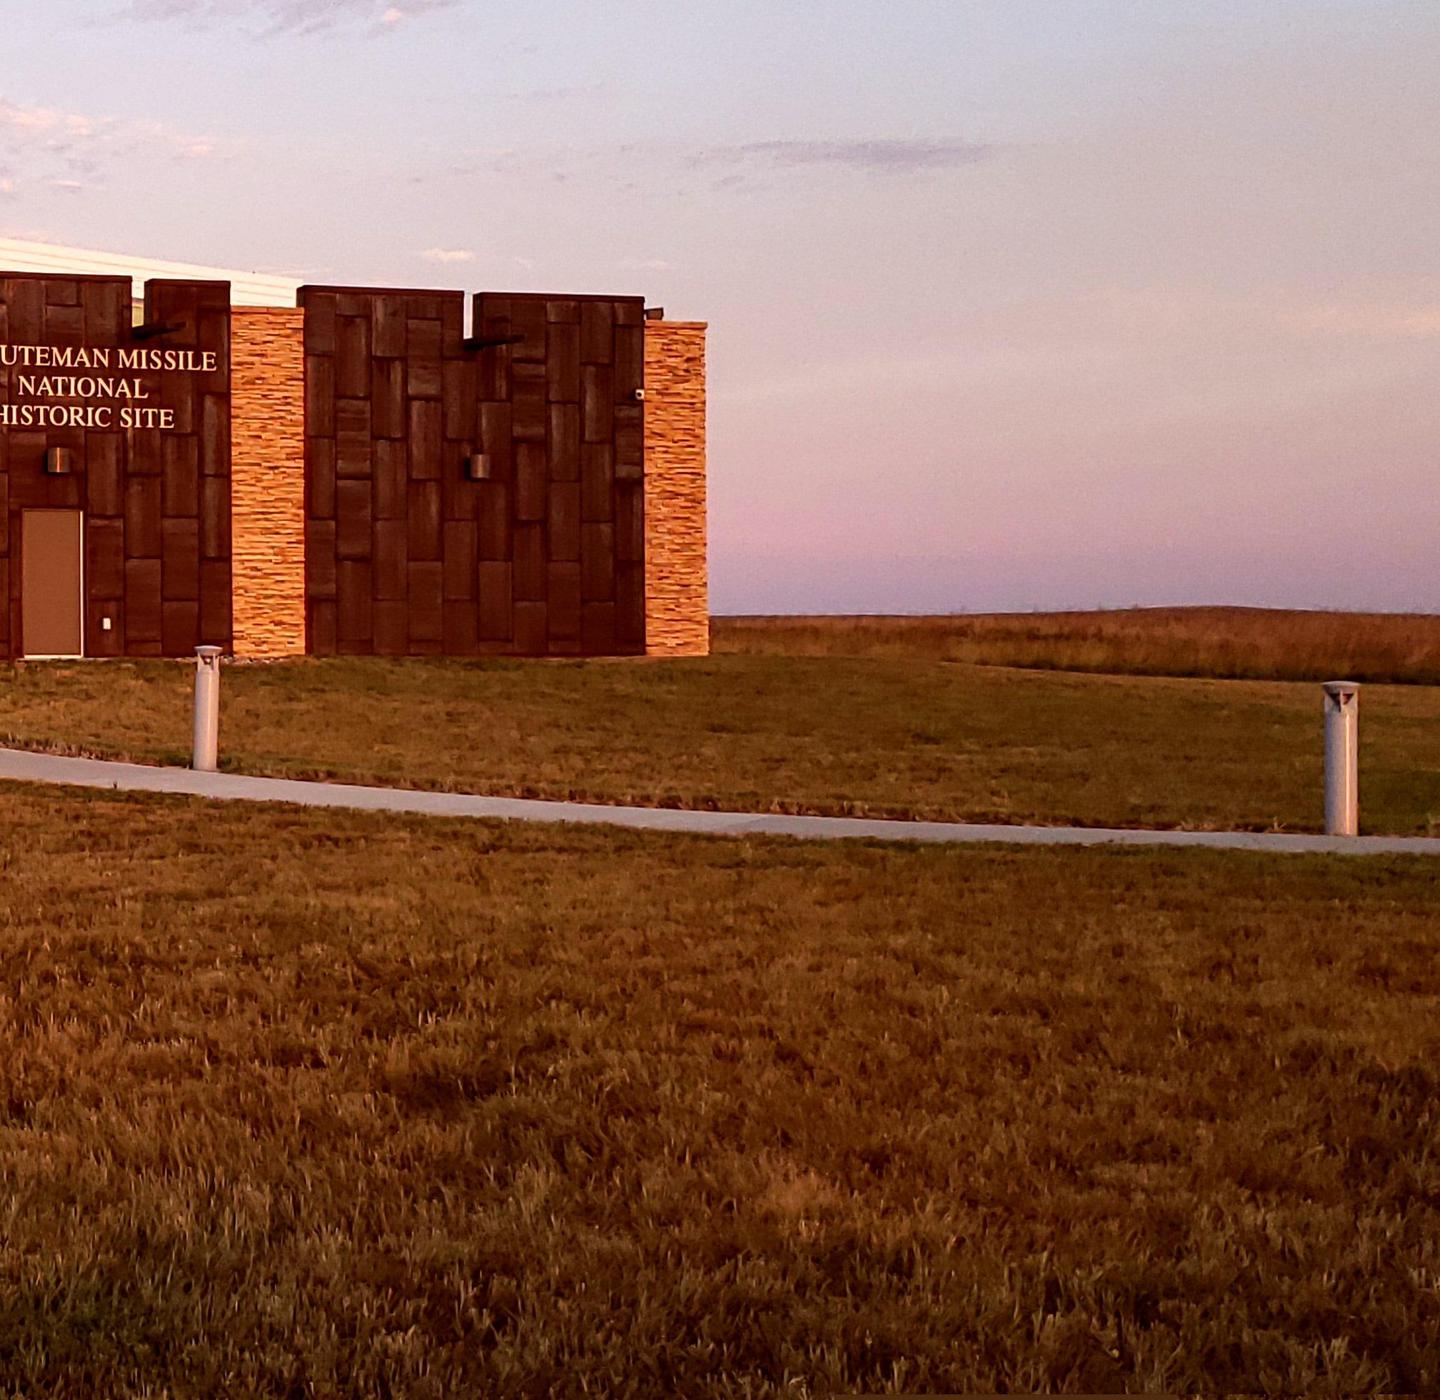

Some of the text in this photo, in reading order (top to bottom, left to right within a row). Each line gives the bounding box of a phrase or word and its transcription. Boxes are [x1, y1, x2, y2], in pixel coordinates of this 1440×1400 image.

[118, 348, 217, 371] MISSILE
[18, 375, 149, 399] NATIONAL
[120, 408, 175, 429] SITE
